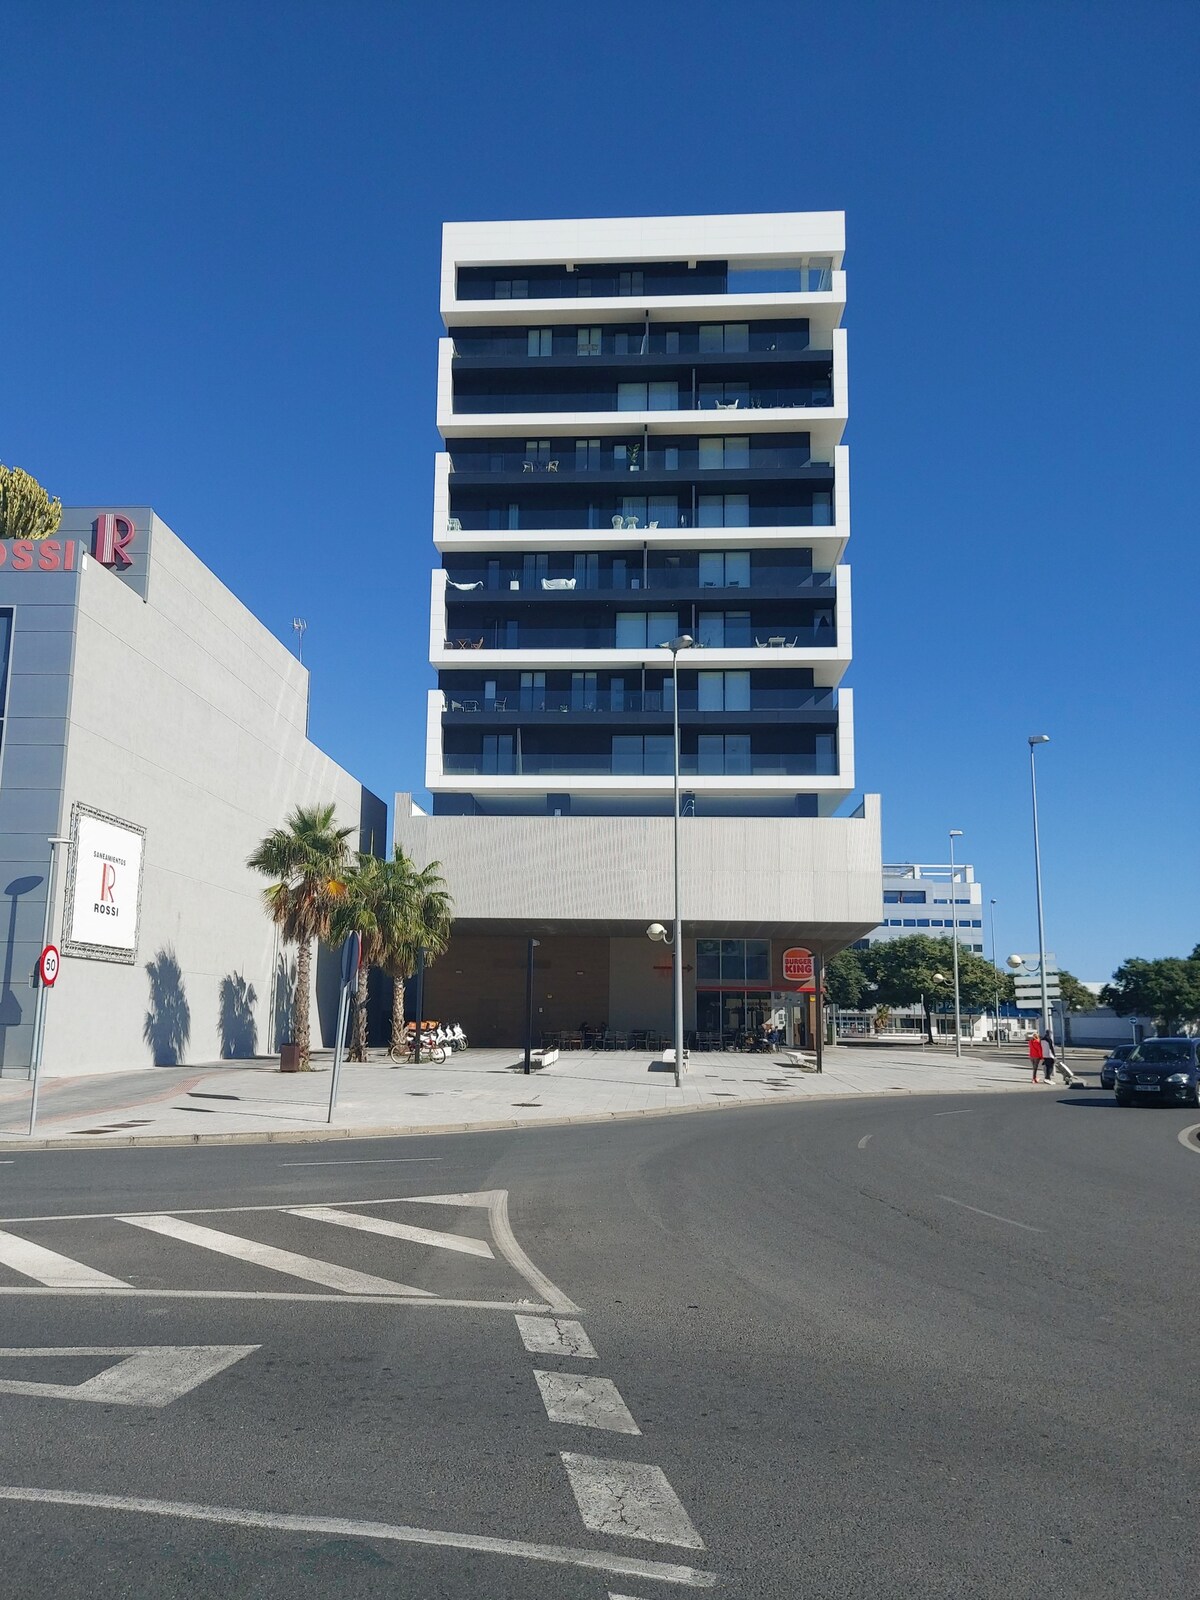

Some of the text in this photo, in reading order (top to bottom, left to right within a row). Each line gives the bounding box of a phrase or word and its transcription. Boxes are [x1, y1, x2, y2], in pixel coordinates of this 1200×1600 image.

[93, 851, 126, 866] SANEAMIENTOS
[94, 903, 119, 917] ROSSI
[46, 959, 56, 971] 50
[785, 965, 812, 973] KING
